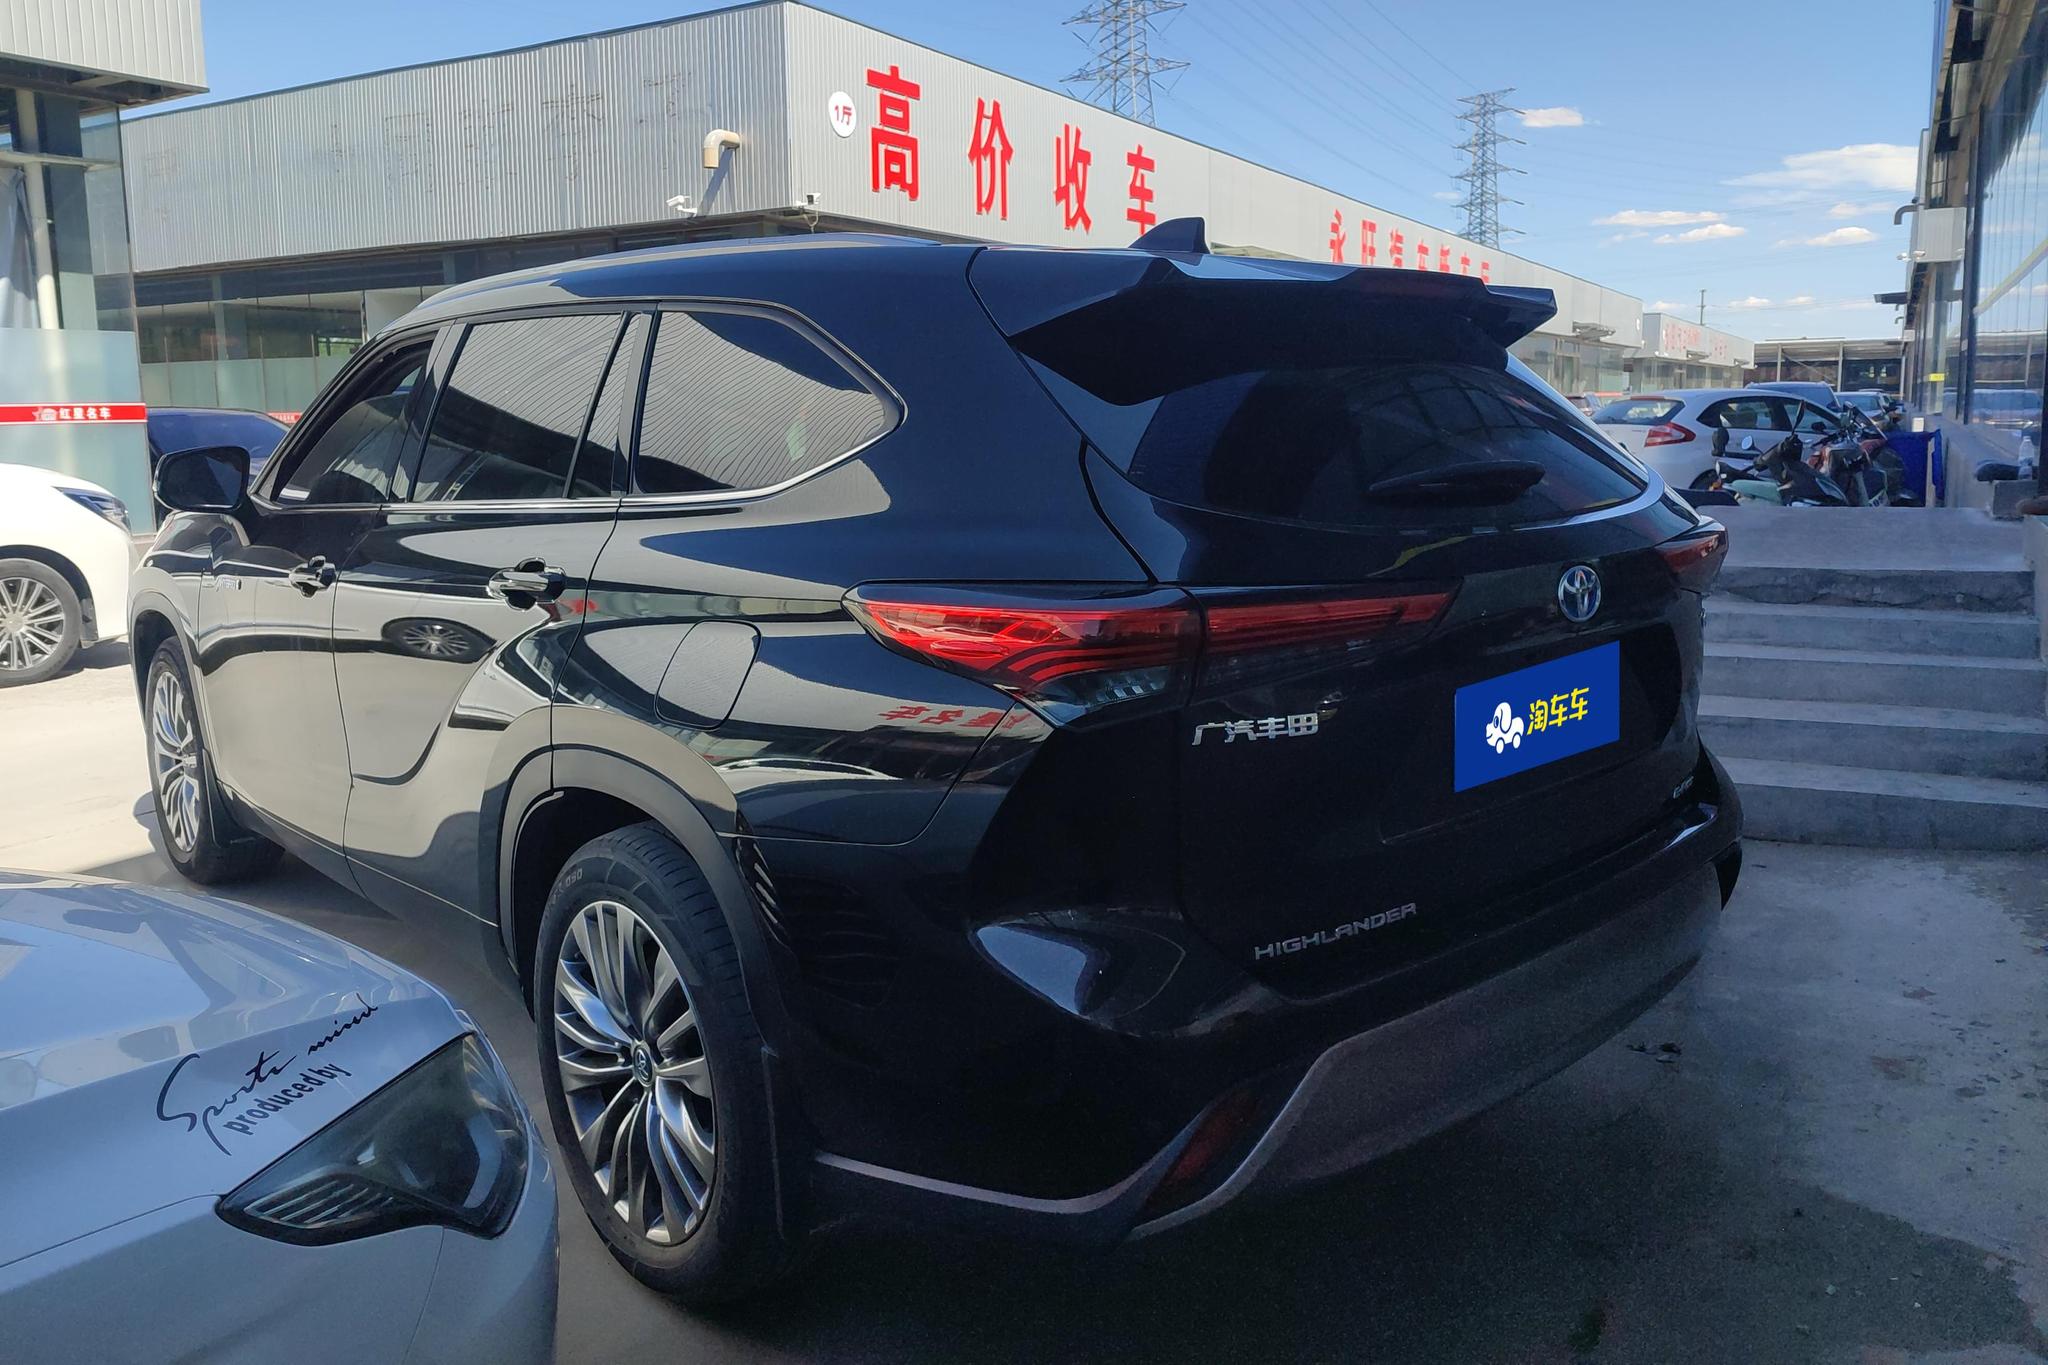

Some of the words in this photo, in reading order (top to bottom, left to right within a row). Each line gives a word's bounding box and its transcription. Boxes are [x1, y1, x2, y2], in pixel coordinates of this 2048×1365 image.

[866, 65, 1156, 236] 高价收车
[1191, 712, 1319, 746] 广汽丰田
[1254, 902, 1417, 960] HIGHLANDER
